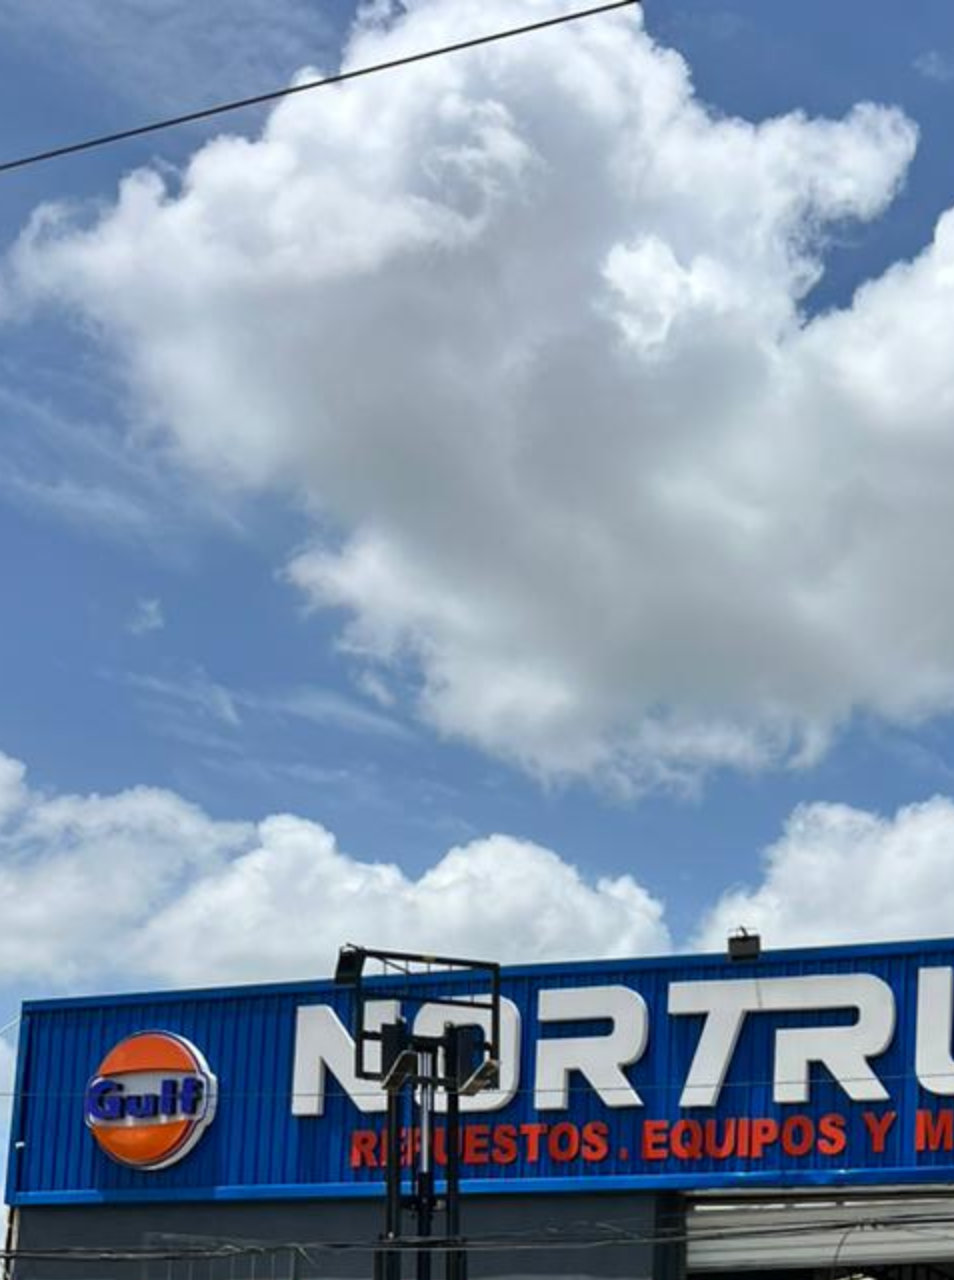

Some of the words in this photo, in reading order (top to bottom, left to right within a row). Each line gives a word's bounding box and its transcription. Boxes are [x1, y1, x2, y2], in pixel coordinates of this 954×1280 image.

[87, 1077, 204, 1121] Gulf
[642, 1113, 847, 1160] EQUIPOS
[863, 1109, 897, 1153] Y
